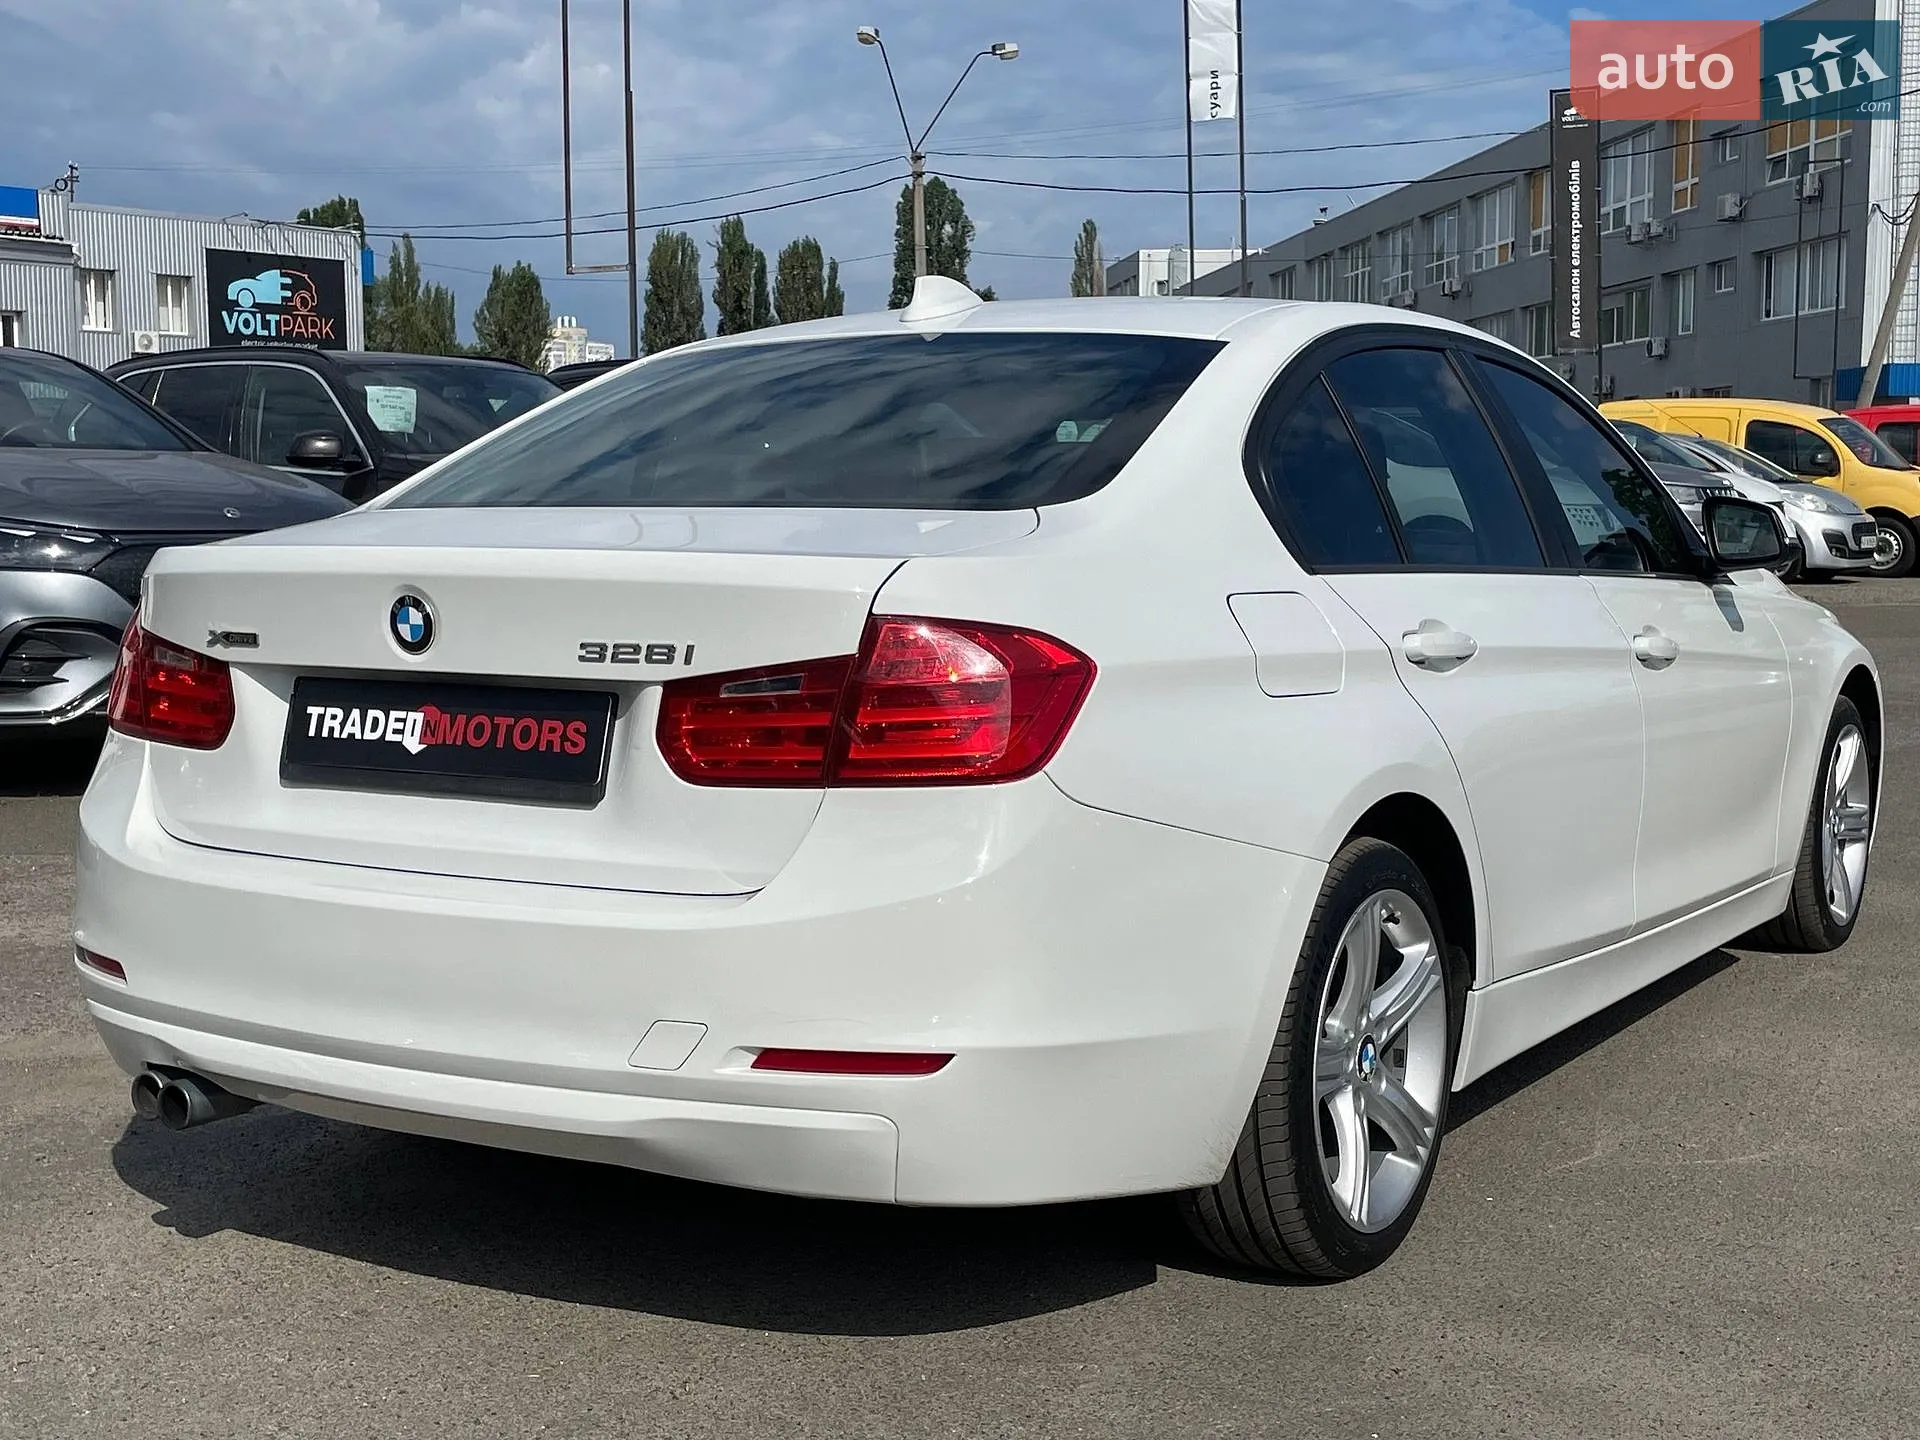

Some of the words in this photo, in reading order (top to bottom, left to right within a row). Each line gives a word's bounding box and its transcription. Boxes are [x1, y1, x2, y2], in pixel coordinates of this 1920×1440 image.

[1209, 70, 1222, 118] суари
[1568, 160, 1583, 266] електромобілів
[221, 310, 335, 340] VOLTPARK
[1569, 269, 1581, 339] Автосалон
